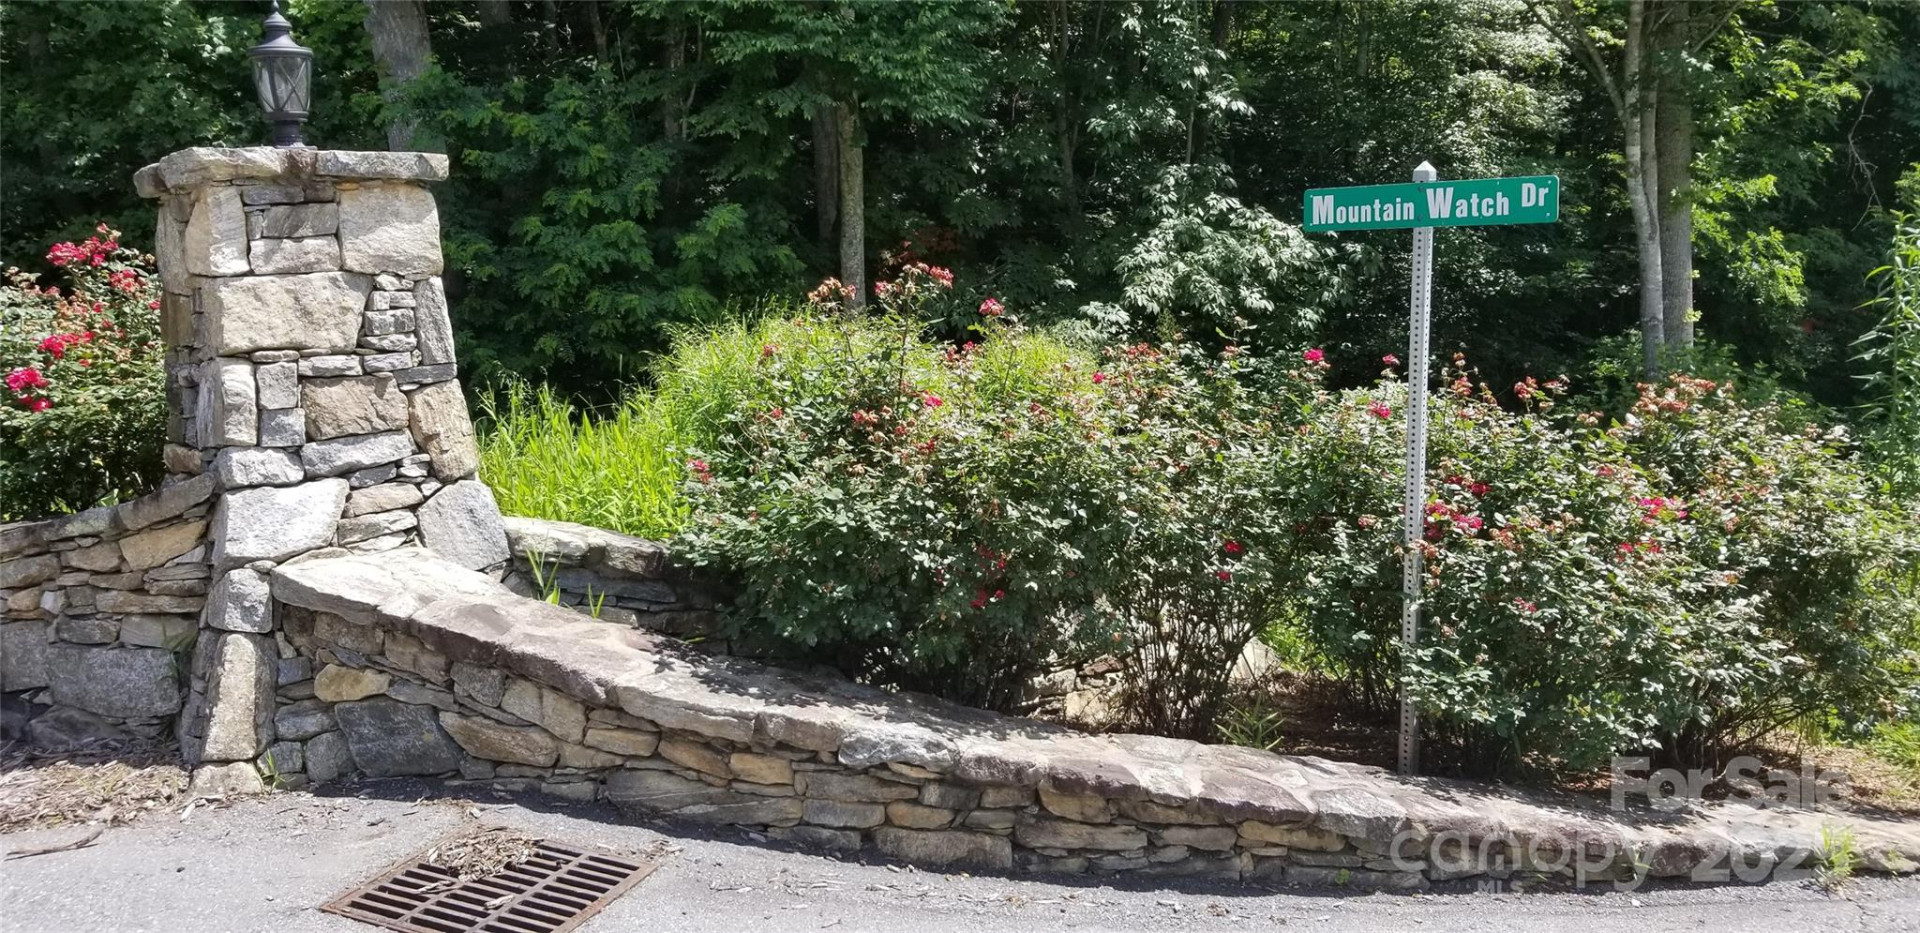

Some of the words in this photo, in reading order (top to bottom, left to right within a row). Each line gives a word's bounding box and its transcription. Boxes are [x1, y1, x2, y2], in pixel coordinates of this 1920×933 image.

[1311, 194, 1415, 226] Mountain
[1425, 186, 1510, 220] Watch
[1521, 182, 1549, 208] Dr
